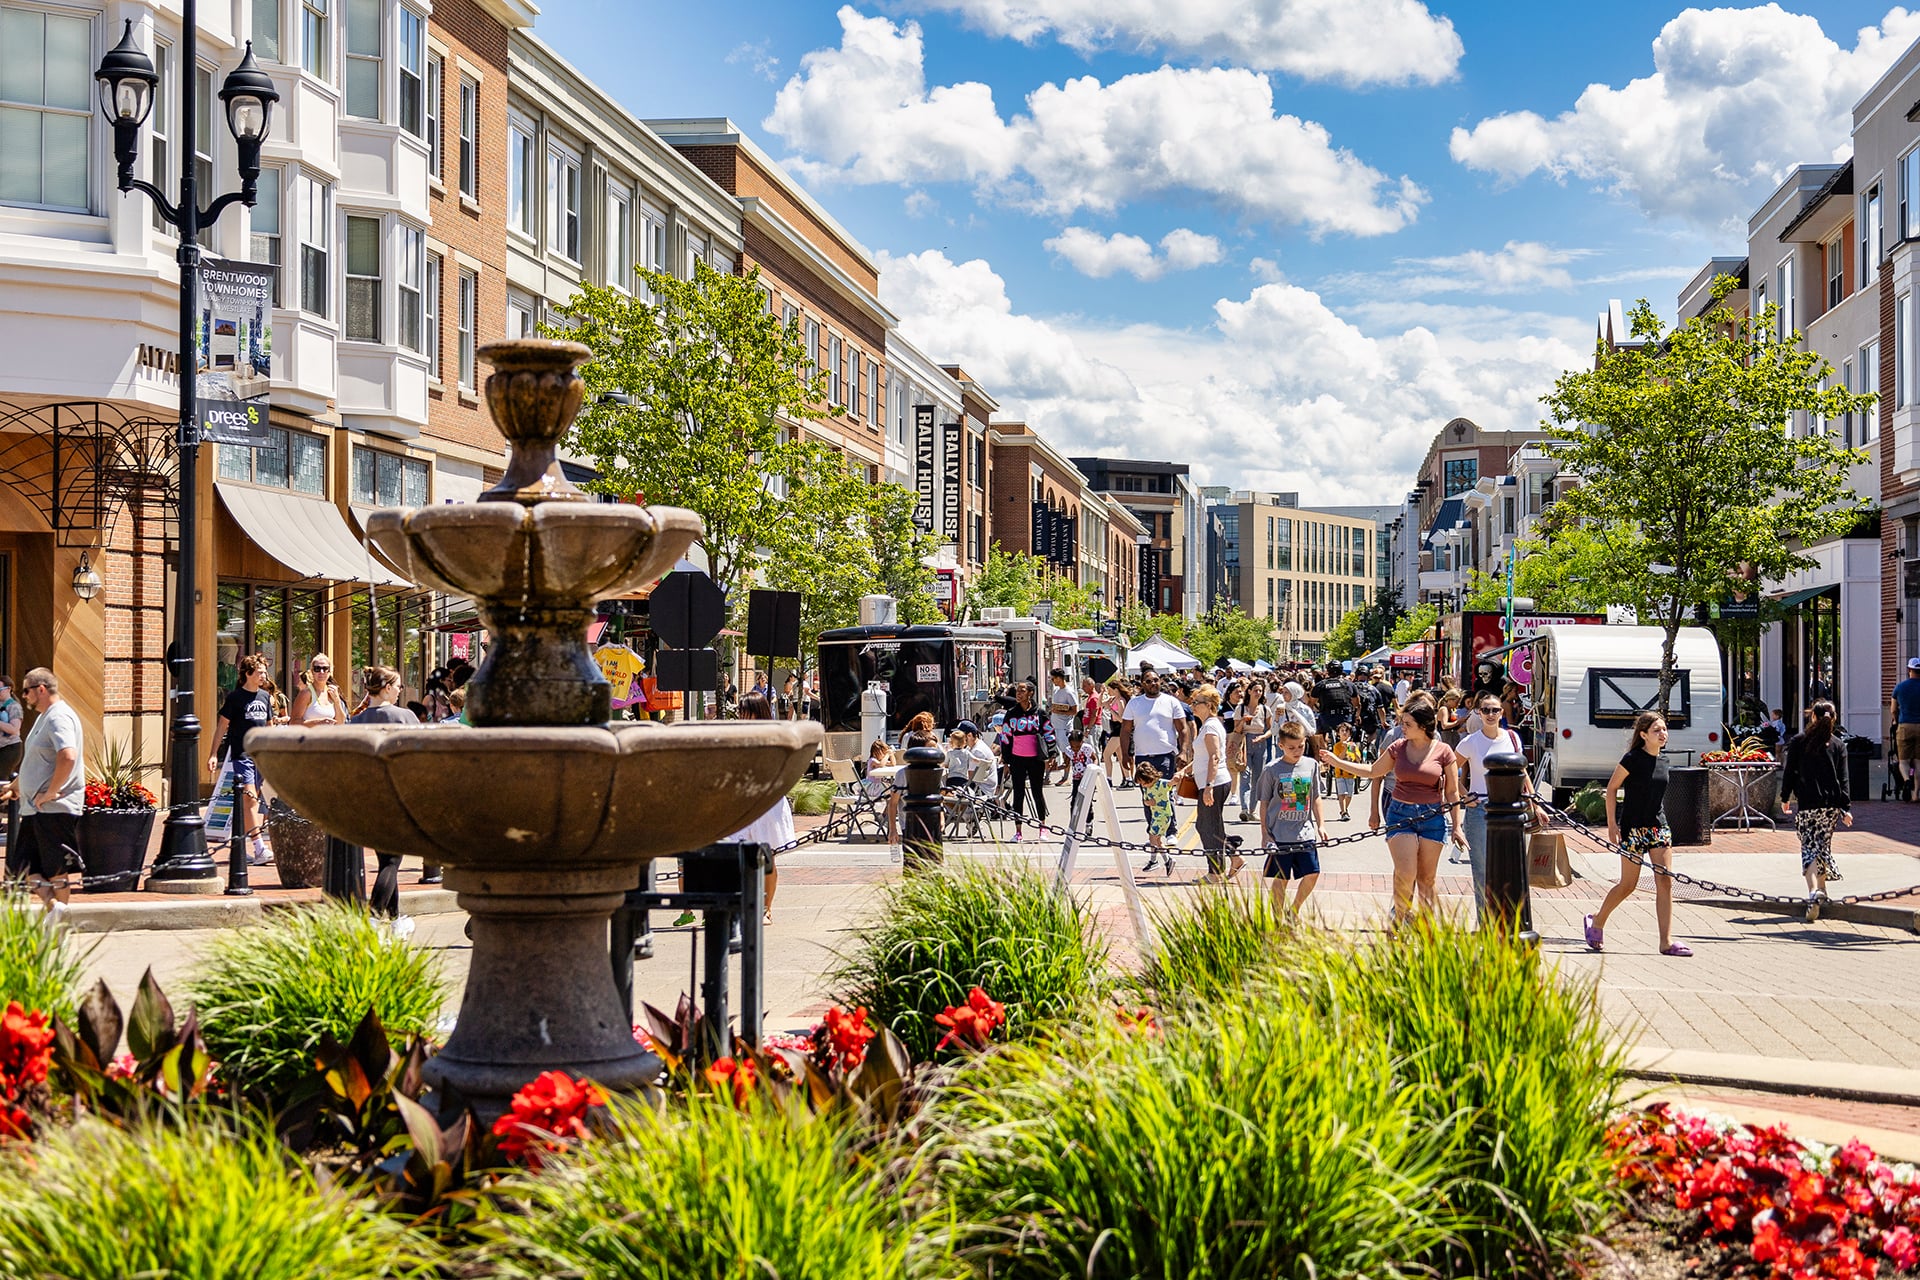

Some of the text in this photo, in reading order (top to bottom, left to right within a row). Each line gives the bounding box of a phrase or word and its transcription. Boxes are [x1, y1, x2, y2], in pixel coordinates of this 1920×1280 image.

[201, 281, 268, 299] TOWNHOMES
[203, 269, 268, 286] BRENTWOOD
[918, 412, 932, 465] RALLY
[944, 430, 959, 539] RALLY HOUSE
